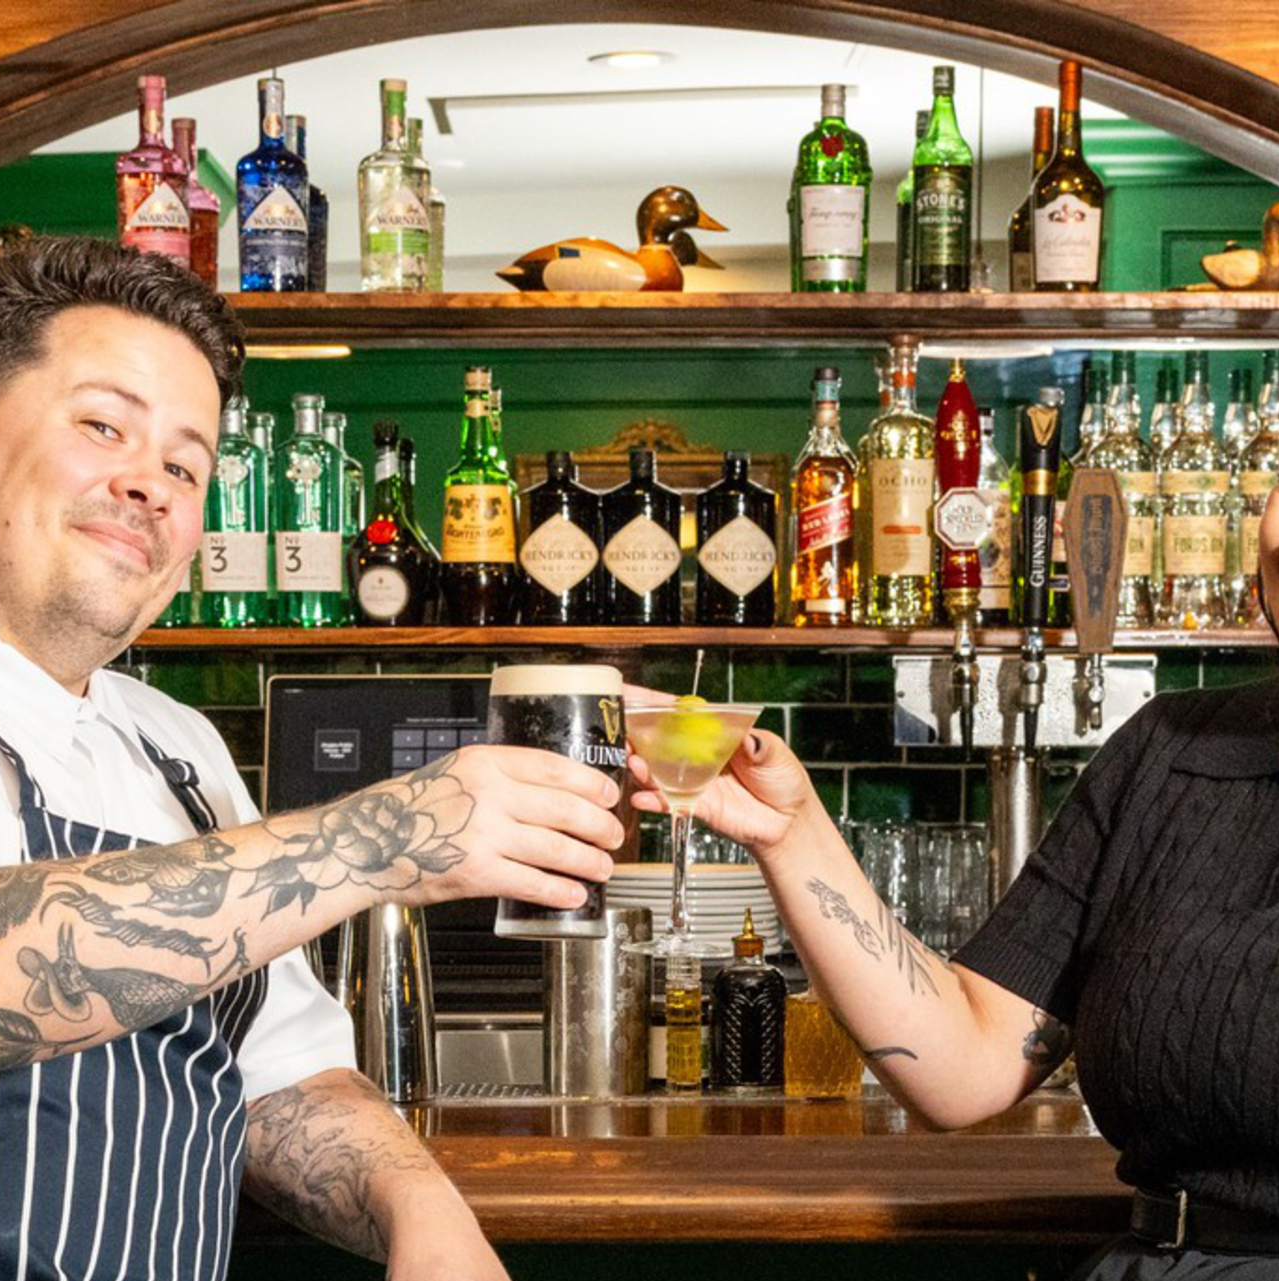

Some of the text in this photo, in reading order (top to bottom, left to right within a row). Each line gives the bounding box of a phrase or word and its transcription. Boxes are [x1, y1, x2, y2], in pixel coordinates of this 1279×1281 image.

[210, 546, 228, 573] 3
[285, 546, 302, 573] 3
[1030, 514, 1047, 588] GUINNESS
